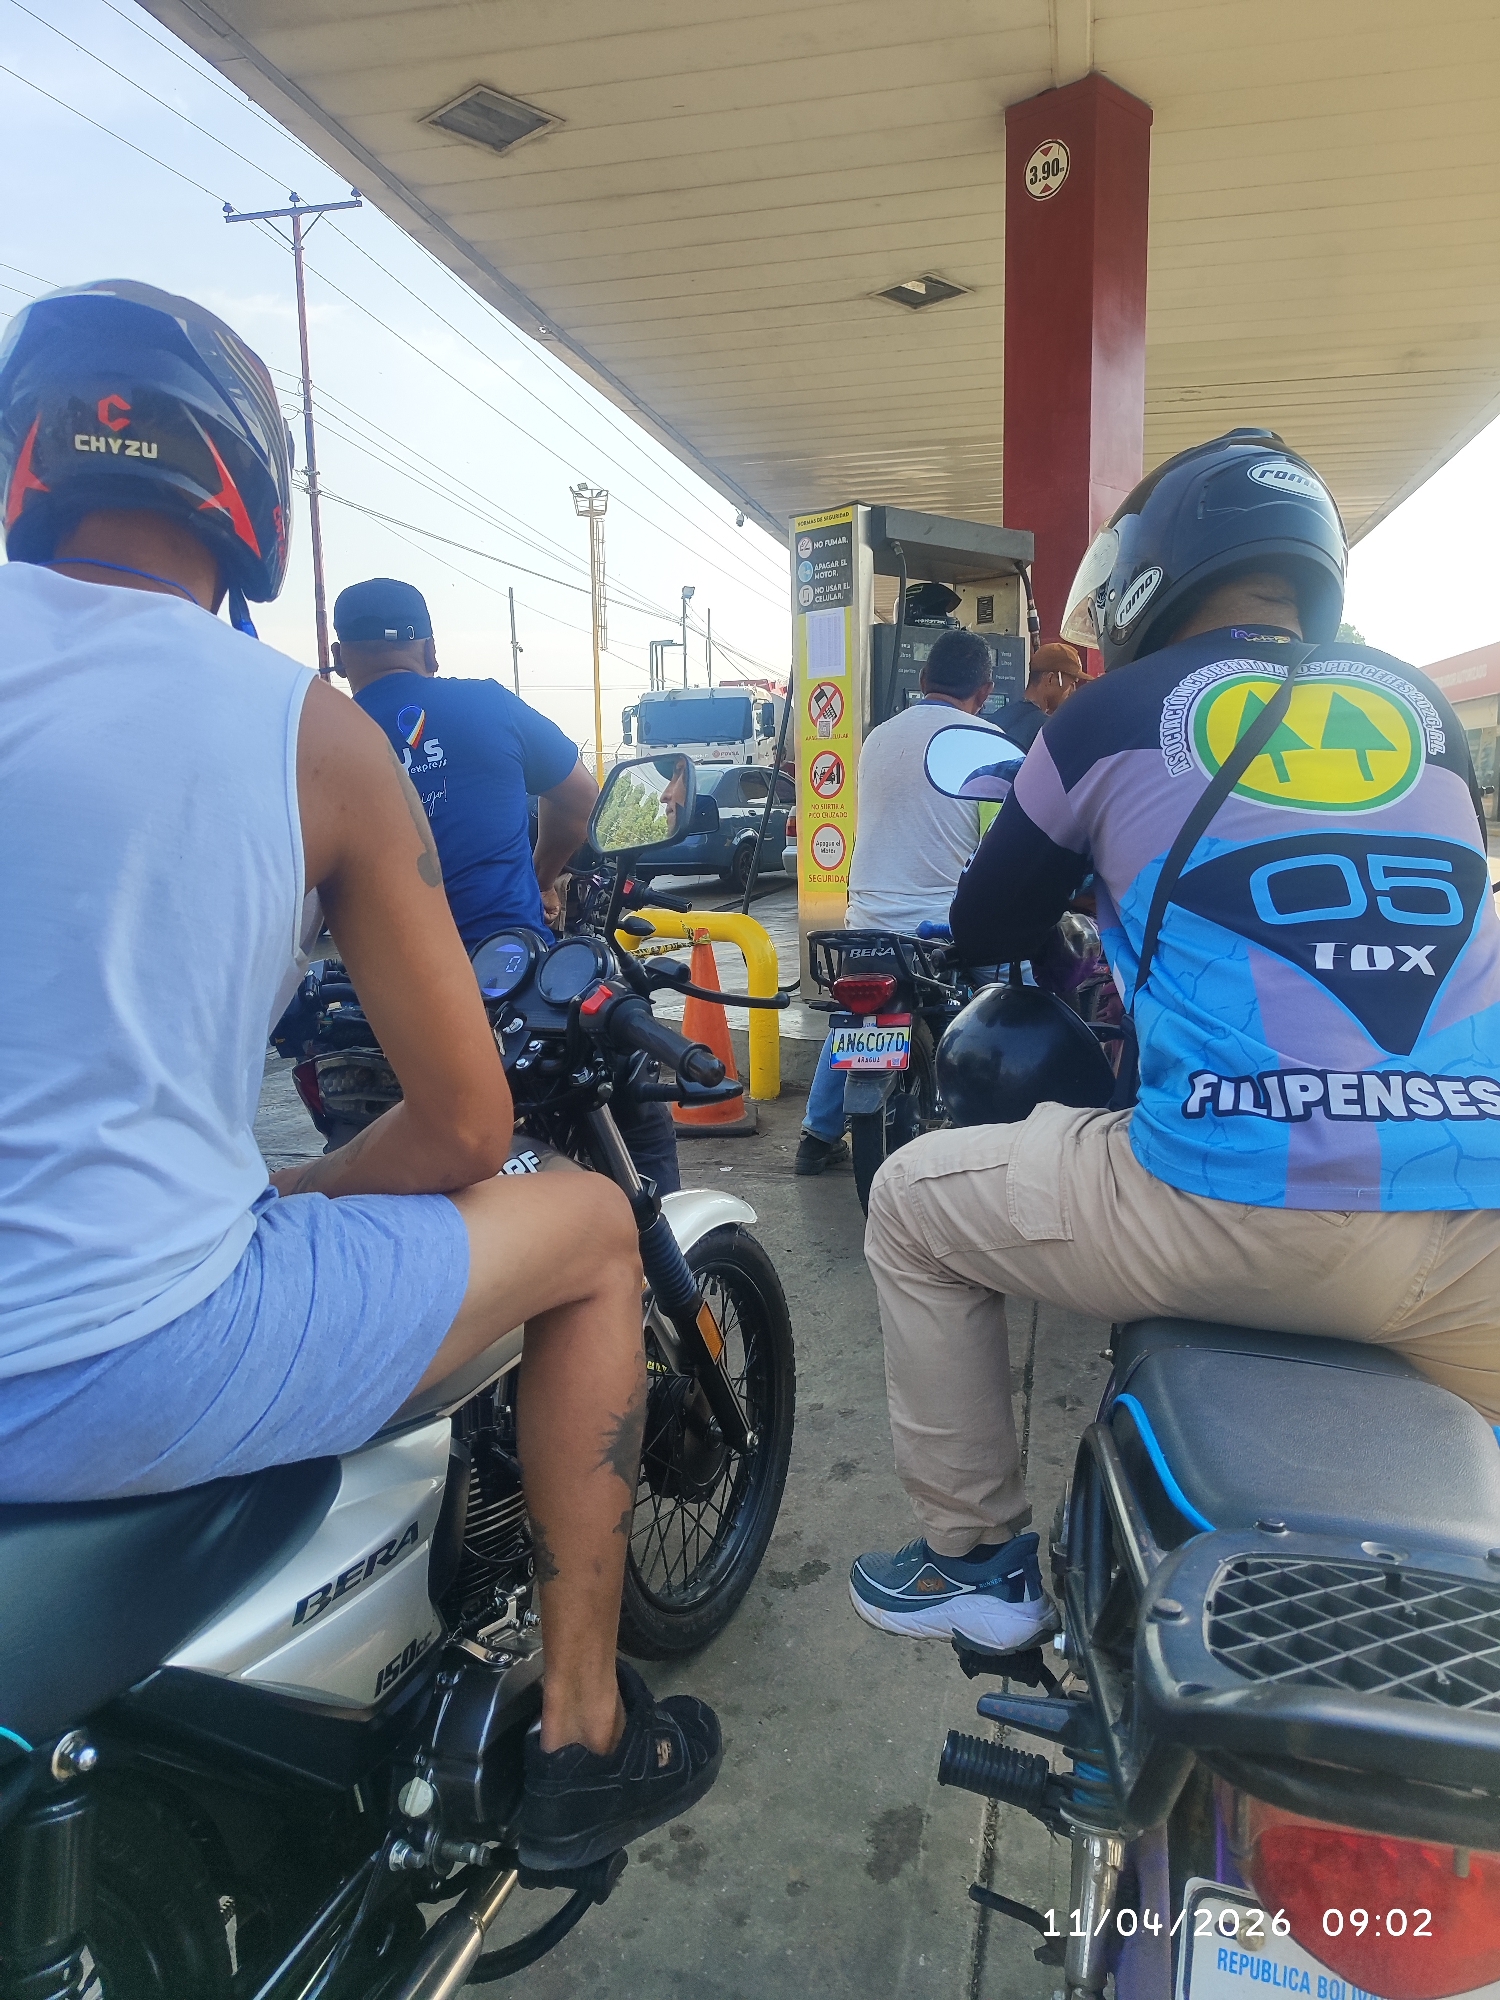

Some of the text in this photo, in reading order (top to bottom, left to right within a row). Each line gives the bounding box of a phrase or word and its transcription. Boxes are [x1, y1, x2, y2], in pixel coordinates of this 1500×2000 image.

[74, 434, 158, 459] CHYZU
[797, 519, 817, 527] NORMAS
[823, 511, 850, 522] SEGURIDAD
[813, 541, 824, 550] NO
[814, 559, 848, 571] APAGAR EL
[814, 582, 851, 595] NO USAR EL
[1324, 660, 1416, 695] PROCERES
[410, 758, 447, 774] express
[811, 803, 819, 811] NO
[808, 811, 848, 819] PICO CRUZADO
[836, 839, 841, 847] el
[1250, 853, 1464, 927] 05
[849, 946, 896, 959] BERA
[1184, 1071, 1500, 1120] FILIPENSES
[291, 1520, 419, 1628] BERA
[978, 1577, 1003, 1589] RUNNER
[1216, 1947, 1311, 1995] REPUBLICA
